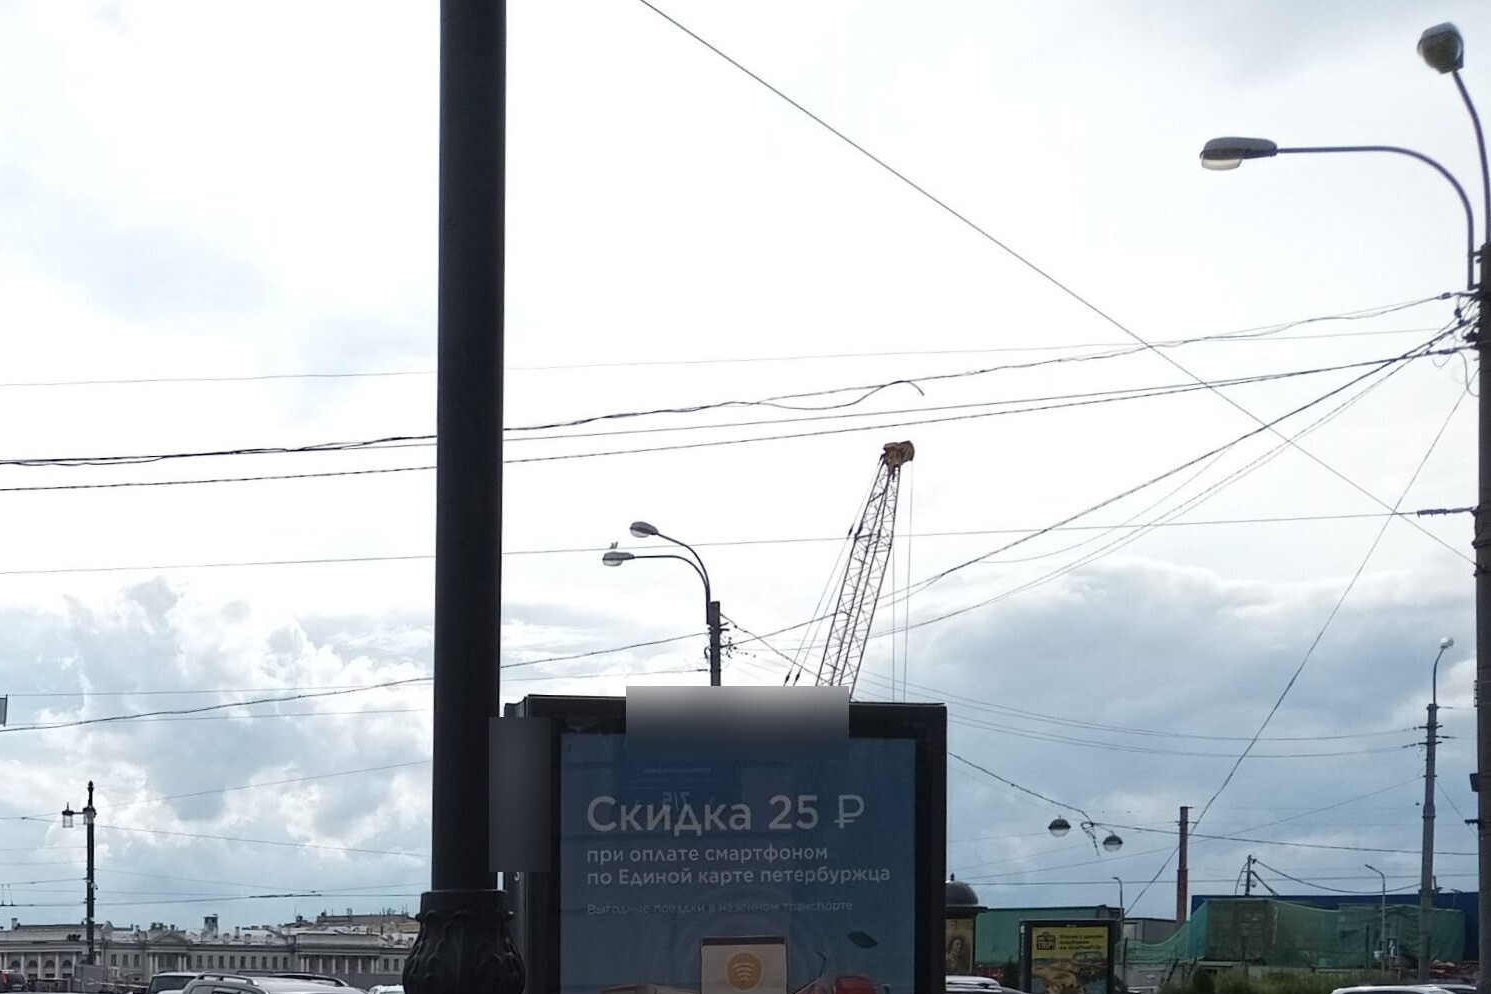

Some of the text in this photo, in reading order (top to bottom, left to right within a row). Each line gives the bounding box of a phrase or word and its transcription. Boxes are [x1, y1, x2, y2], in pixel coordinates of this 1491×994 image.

[587, 795, 752, 836] Скидка
[769, 794, 819, 830] 25
[587, 845, 828, 864] при оплате смартфоном
[587, 866, 891, 887] по Единой карте петербуржца
[587, 901, 853, 915] Выгодные поездки в наземном транспорте
